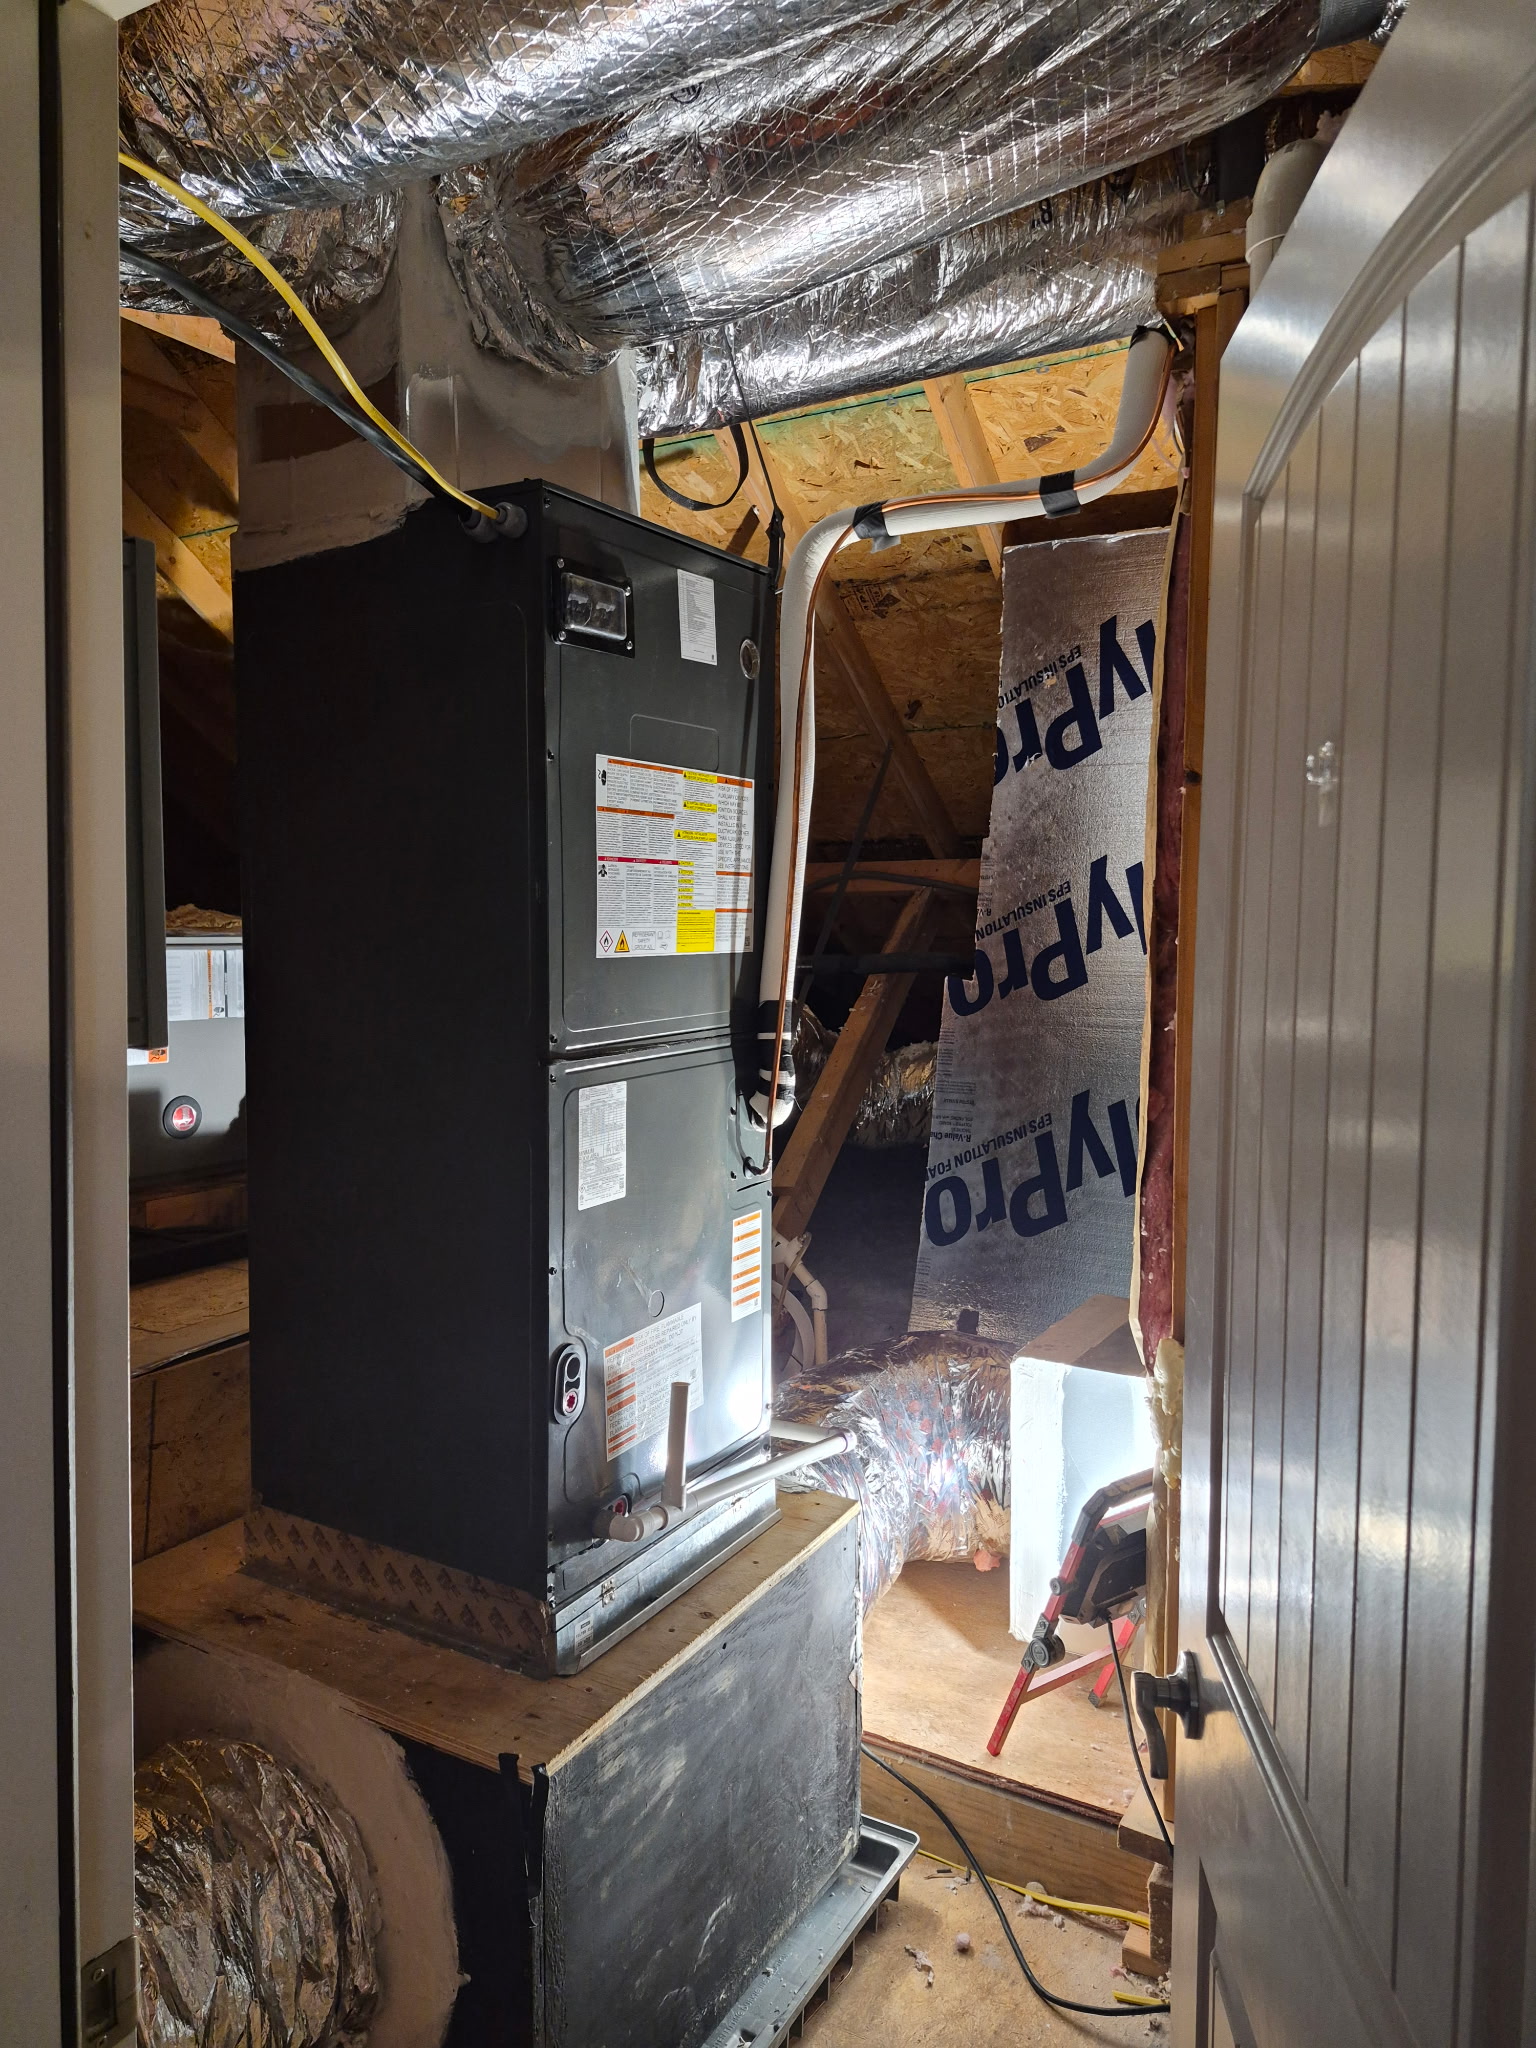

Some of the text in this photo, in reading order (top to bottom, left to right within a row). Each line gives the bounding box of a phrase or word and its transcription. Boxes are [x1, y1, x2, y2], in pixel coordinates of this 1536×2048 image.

[1058, 645, 1082, 669] EPS
[1047, 880, 1071, 903] EPS
[975, 894, 1047, 942] INSULATION
[925, 1112, 1053, 1181] EPS INSULATION FOA
[944, 1132, 971, 1143] R-Value
[925, 1090, 1141, 1247] lyPro
